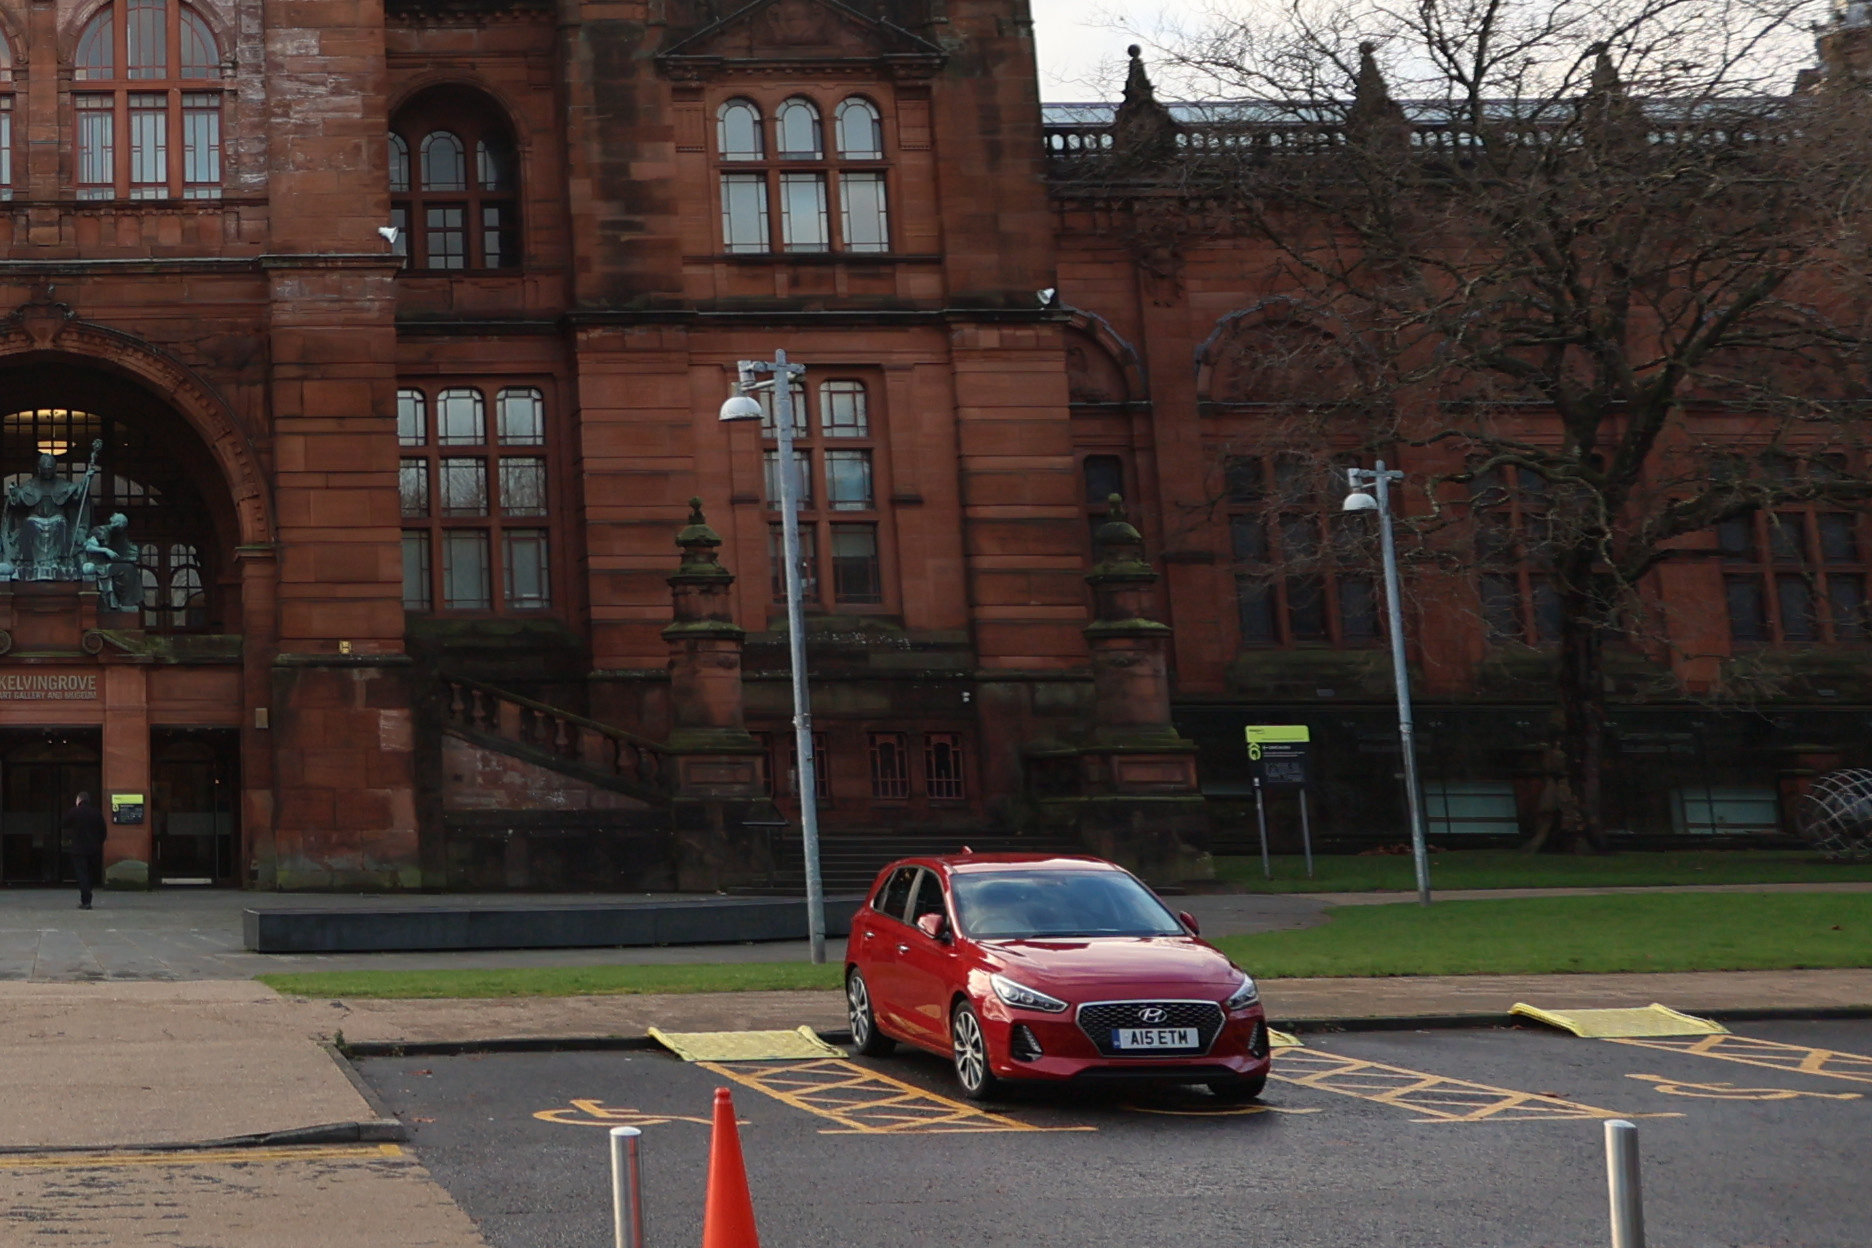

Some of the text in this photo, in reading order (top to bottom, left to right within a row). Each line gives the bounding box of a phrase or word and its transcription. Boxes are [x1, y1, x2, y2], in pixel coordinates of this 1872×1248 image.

[14, 691, 45, 700] GALLERY
[47, 691, 62, 700] AND
[64, 691, 97, 700] MUSEUM
[1131, 1029, 1188, 1046] A15 ETM
